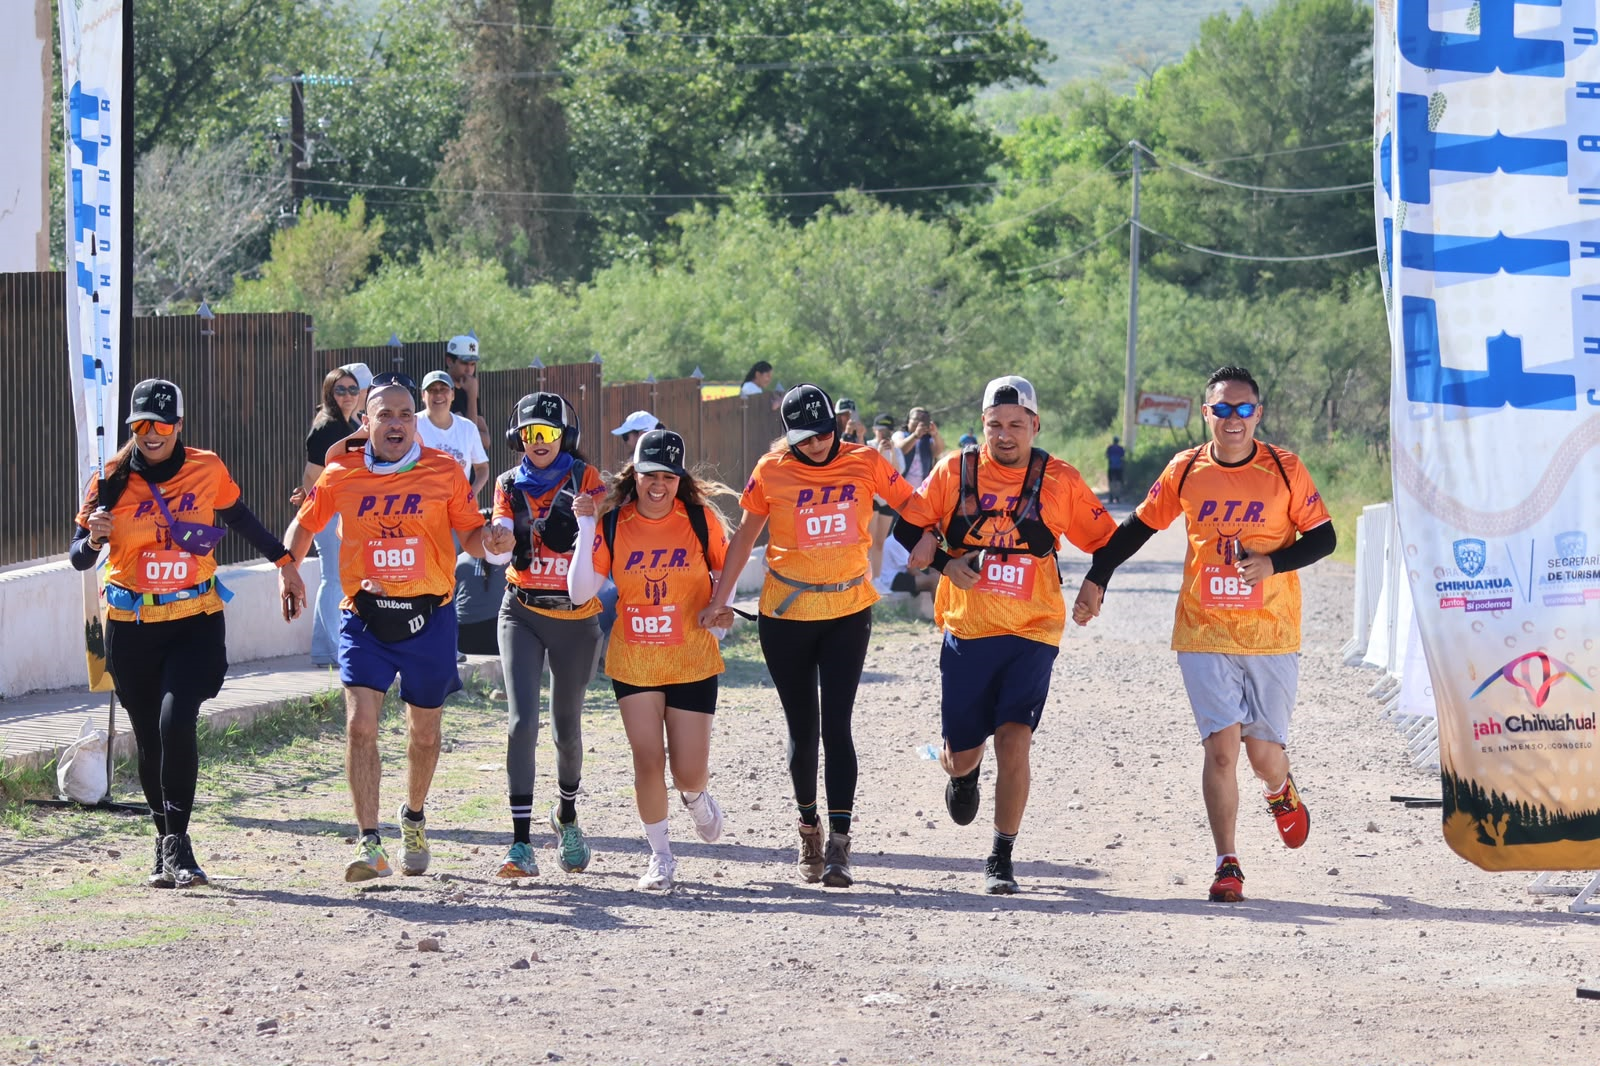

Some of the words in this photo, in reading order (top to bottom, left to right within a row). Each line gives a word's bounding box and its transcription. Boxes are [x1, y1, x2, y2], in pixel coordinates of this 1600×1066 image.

[357, 493, 423, 517] P.T.R.
[796, 484, 858, 508] P.T.R.
[1197, 500, 1266, 522] P.T.R.
[806, 513, 847, 536] 073
[373, 548, 415, 567] 080
[530, 557, 568, 576] 078
[624, 548, 690, 571] P.T.R.
[146, 561, 188, 580] 070
[987, 564, 1024, 585] 081
[1547, 571, 1563, 581] DE
[1435, 577, 1513, 592] CHIHUAHUA
[375, 599, 413, 610] Wilson
[1441, 599, 1465, 607] Juntos
[1466, 600, 1475, 610] Sí
[1475, 600, 1511, 609] podemos
[631, 615, 673, 633] 082
[1505, 712, 1597, 733] Chihuahua!
